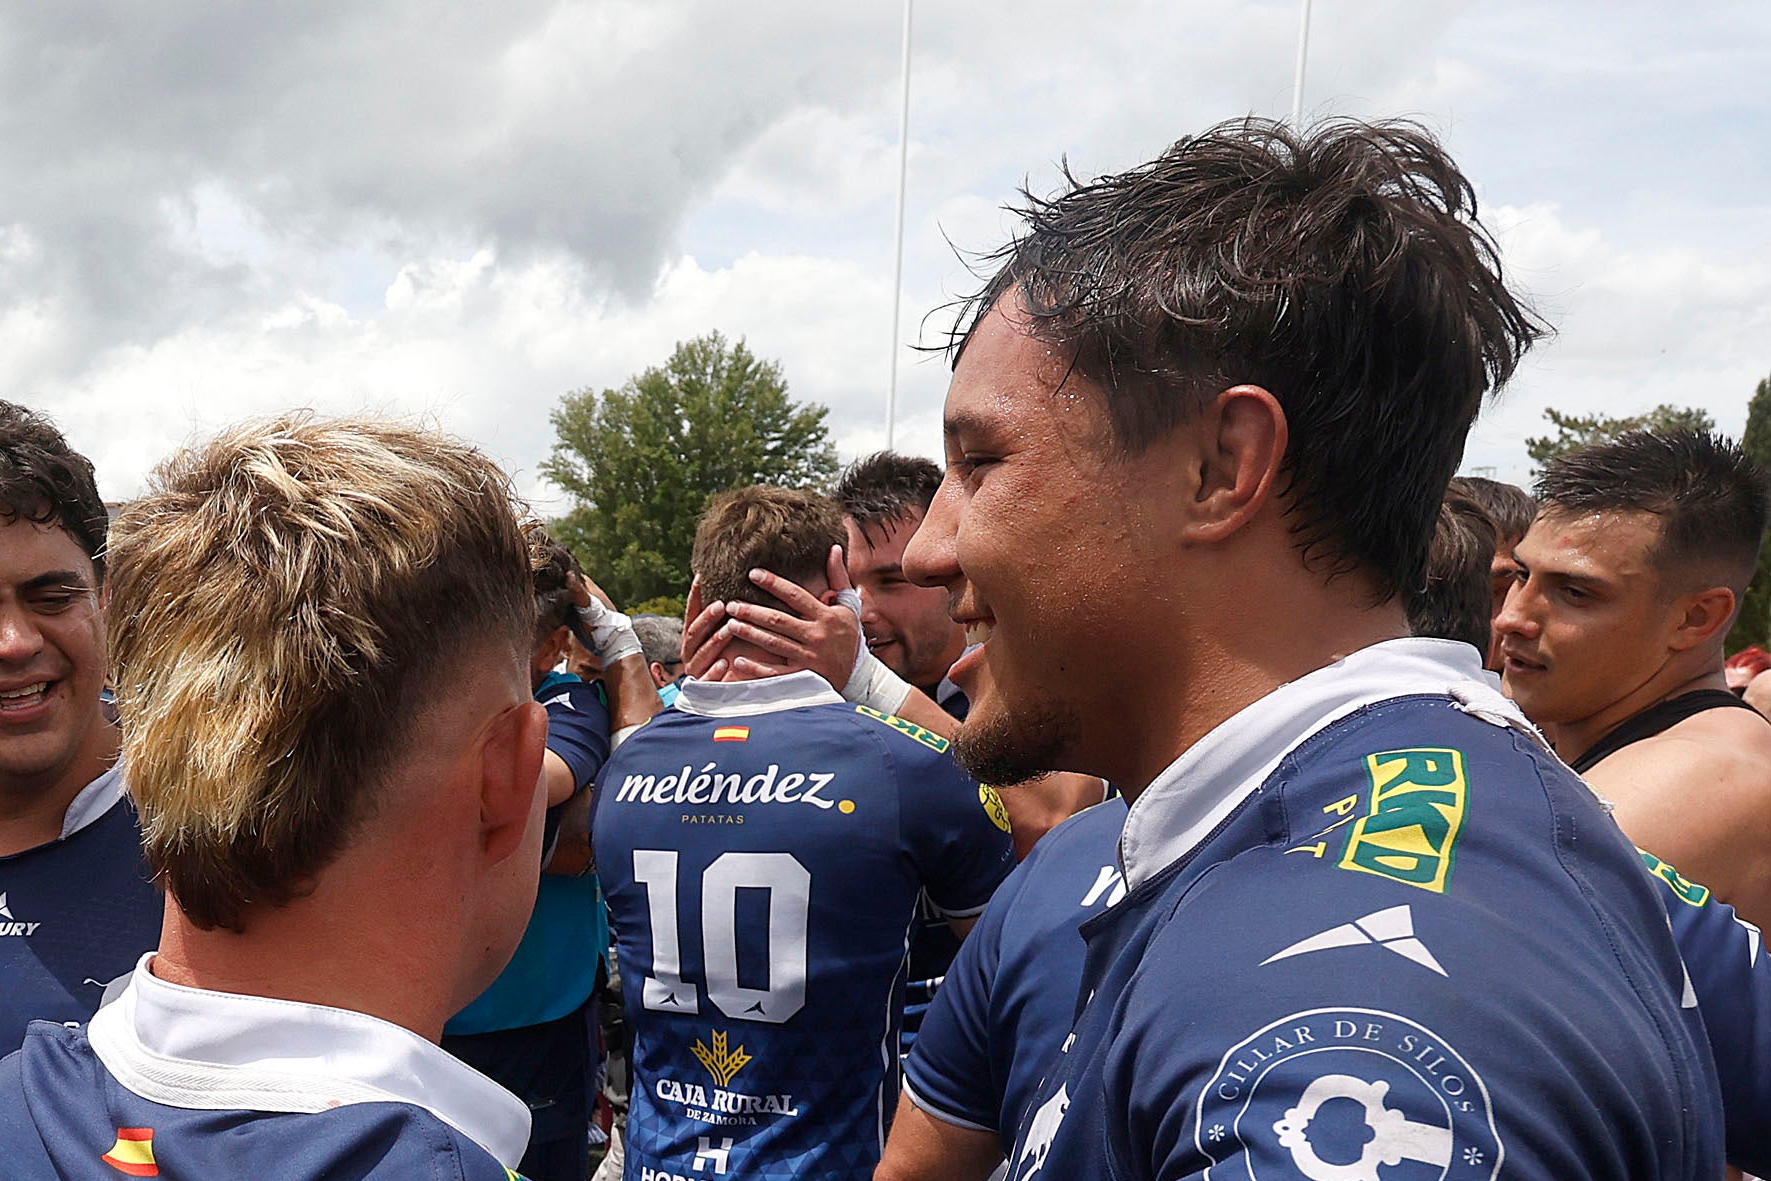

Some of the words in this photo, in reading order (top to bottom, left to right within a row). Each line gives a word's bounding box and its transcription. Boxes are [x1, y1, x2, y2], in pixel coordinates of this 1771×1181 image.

[681, 814, 745, 825] PATATAS
[1351, 751, 1457, 884] RKD
[632, 849, 812, 1025] 10
[655, 1078, 708, 1109] CAJA
[711, 1088, 799, 1117] RURAL
[1217, 1026, 1316, 1101] CILLAR
[1333, 1020, 1384, 1042] DE
[1397, 1034, 1476, 1114] SILOS
[686, 1107, 701, 1119] DE
[702, 1110, 758, 1126] ZAMORA
